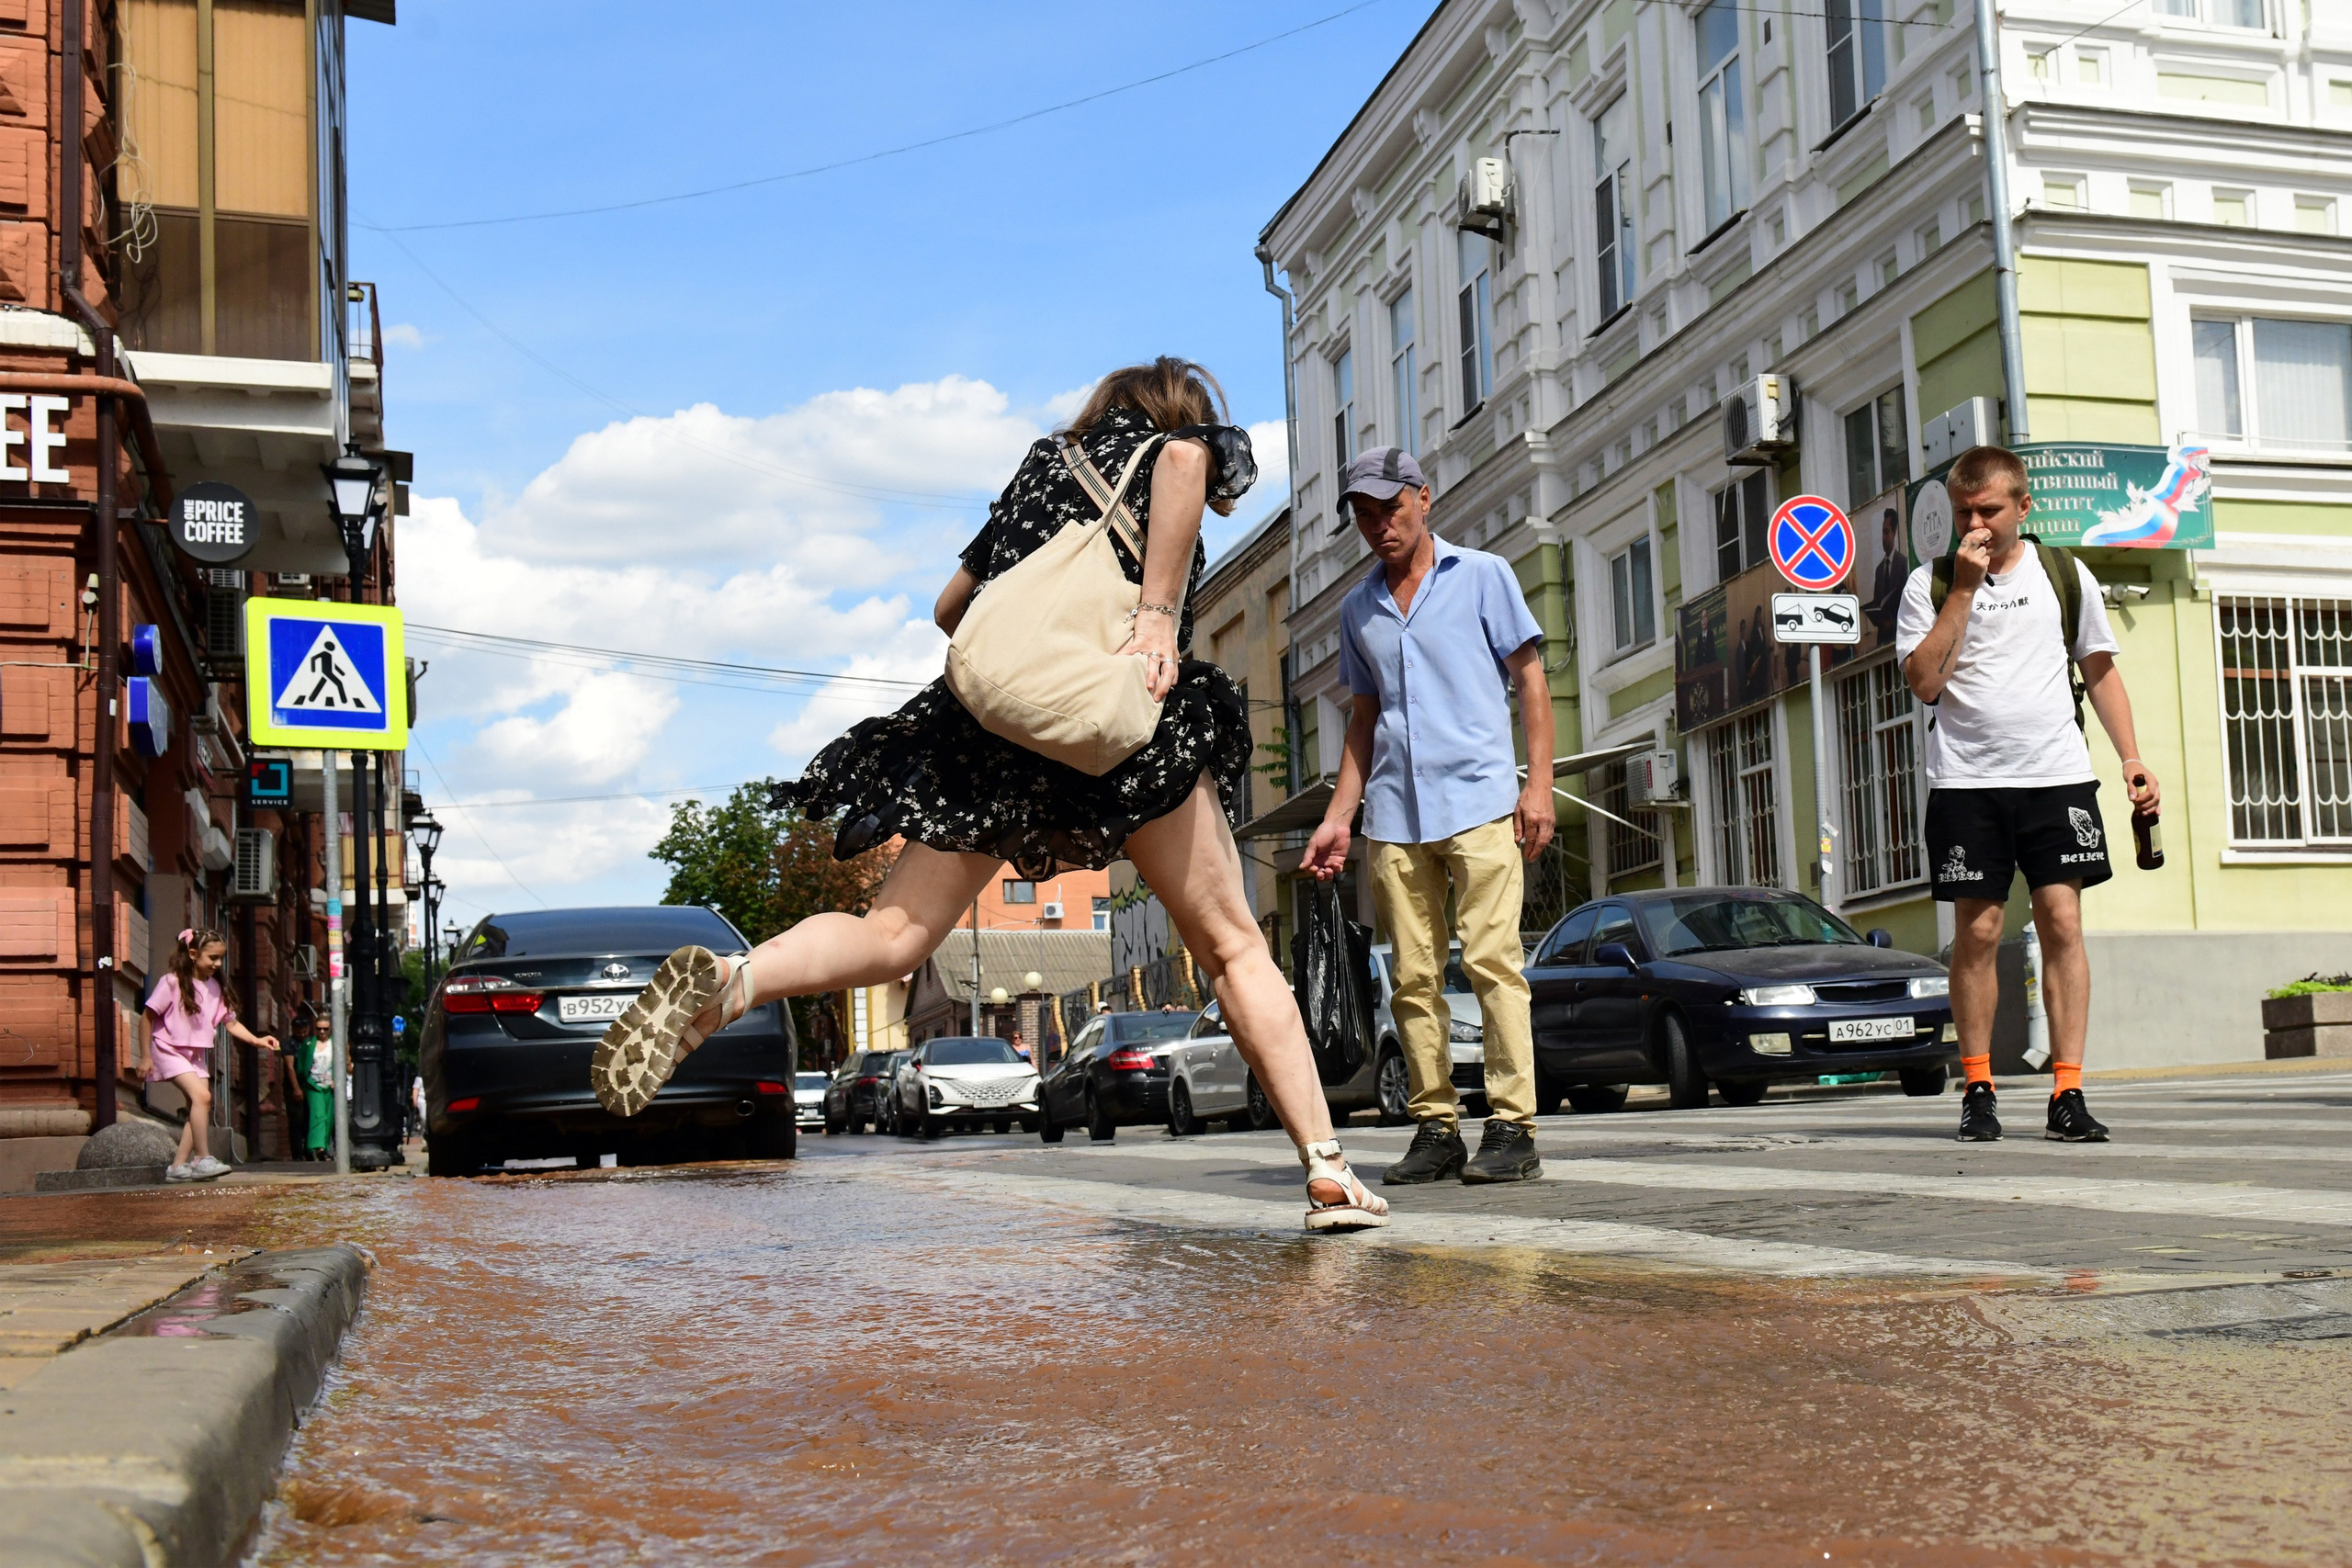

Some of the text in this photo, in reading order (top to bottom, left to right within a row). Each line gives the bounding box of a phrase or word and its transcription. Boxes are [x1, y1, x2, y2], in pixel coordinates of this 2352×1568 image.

[2022, 450, 2105, 469] ИЙСКИЙ
[184, 499, 244, 523] ONE PRICE
[184, 521, 244, 545] COFFEE
[1895, 1020, 1910, 1031] 01
